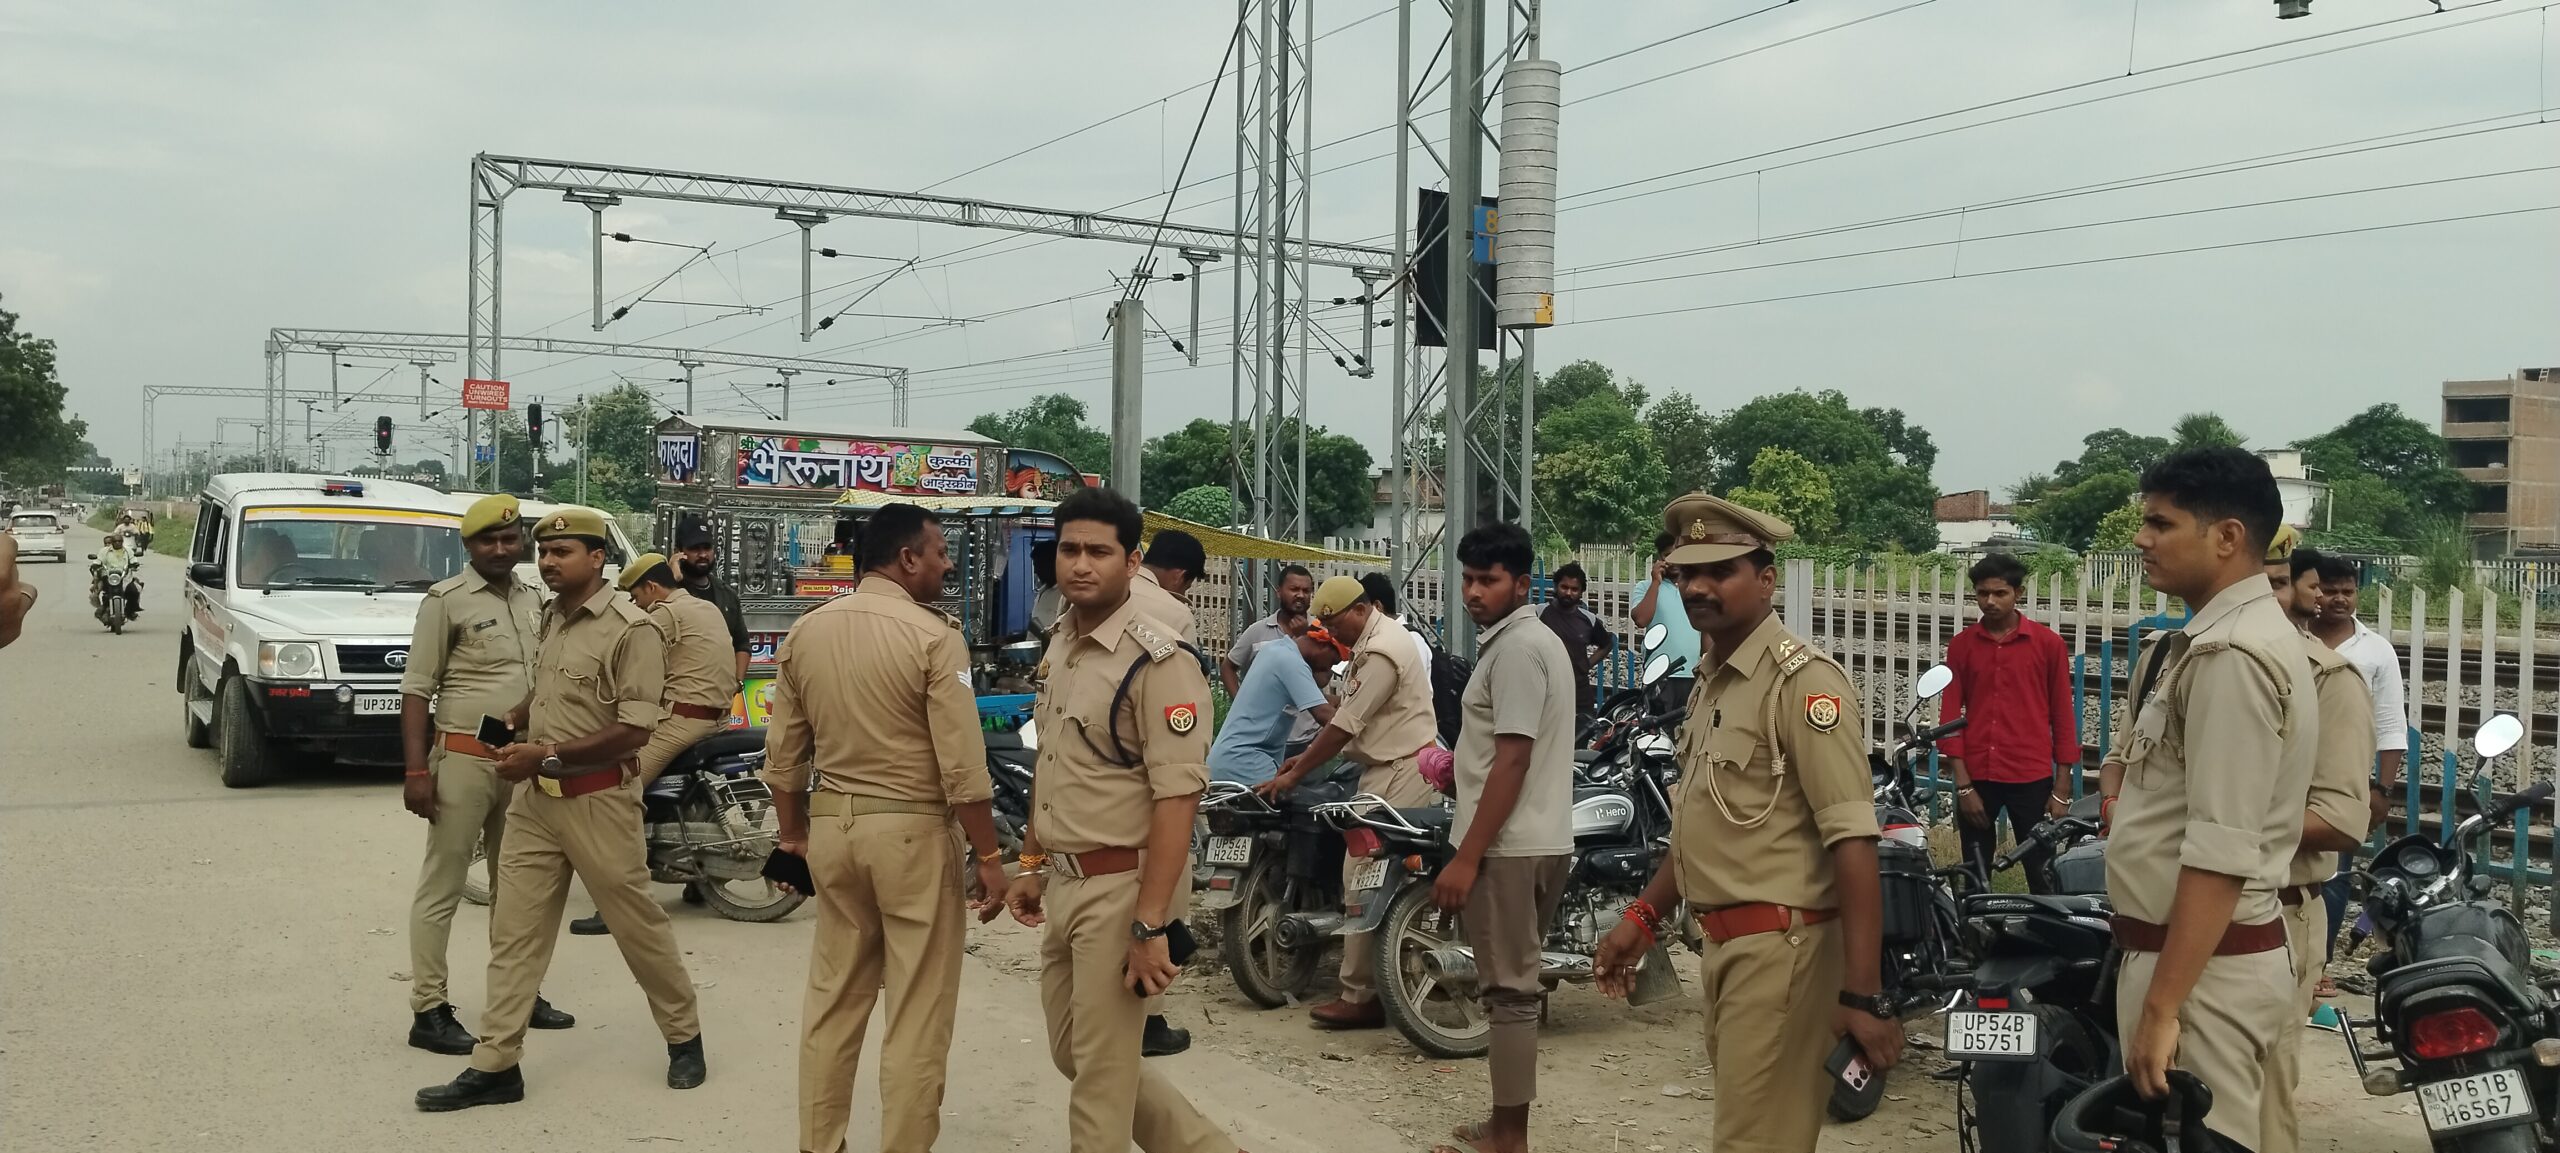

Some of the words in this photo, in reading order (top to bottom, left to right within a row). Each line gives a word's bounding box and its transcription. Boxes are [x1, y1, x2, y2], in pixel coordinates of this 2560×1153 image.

[468, 389, 505, 397] UNWIRED
[470, 383, 505, 391] CAUTION
[464, 394, 508, 403] TURNOUTS
[752, 438, 891, 488] भैरूनाथ
[929, 453, 972, 469] कुल्फी
[1215, 836, 1247, 850] UP54A
[1213, 849, 1246, 862] H2455
[1964, 1014, 2024, 1032] UP54B
[1963, 1034, 2022, 1052] D5751
[2436, 1074, 2508, 1103] UP61B
[2442, 1095, 2512, 1125] H6567
